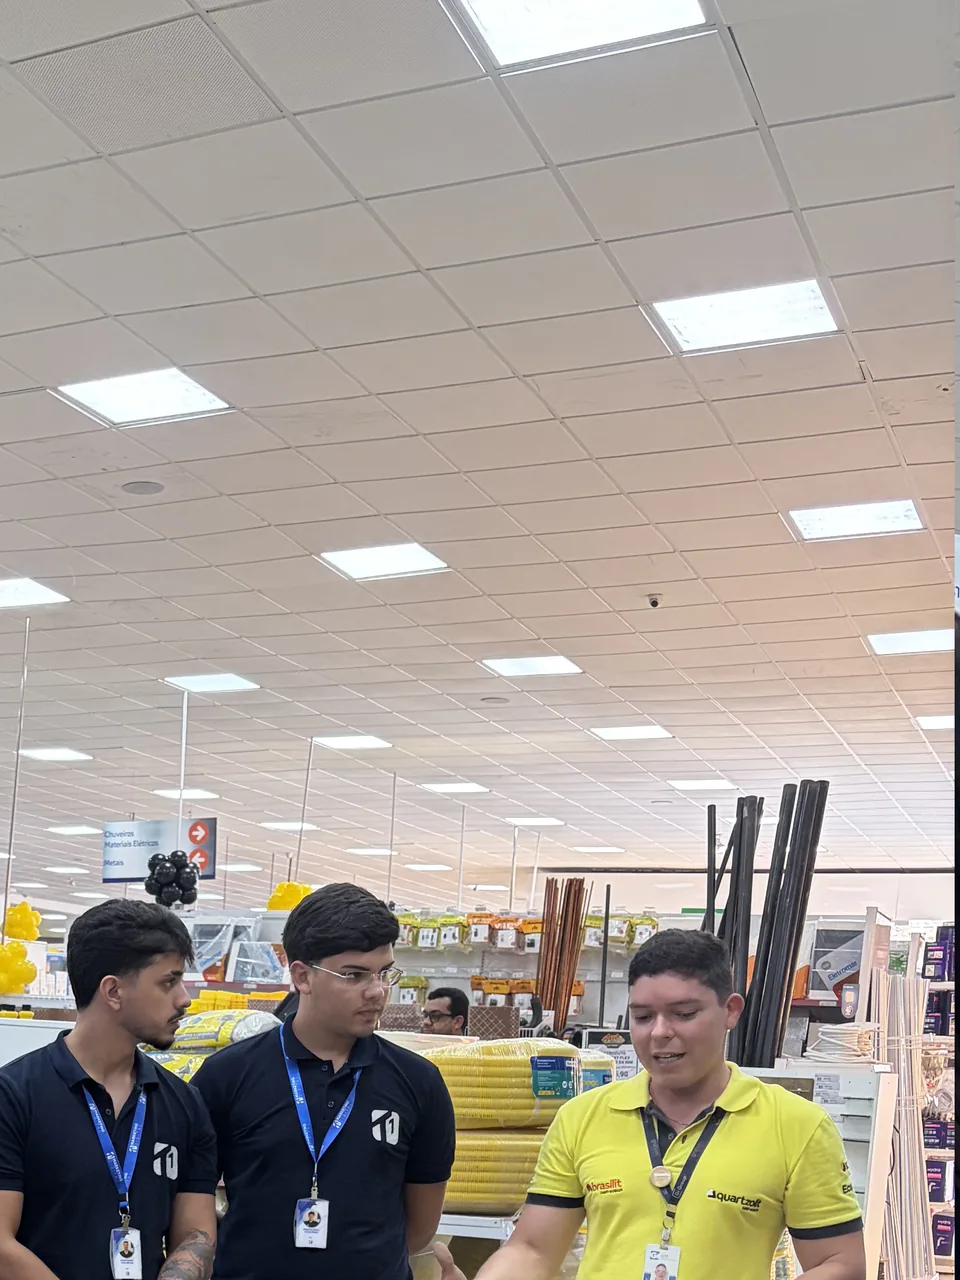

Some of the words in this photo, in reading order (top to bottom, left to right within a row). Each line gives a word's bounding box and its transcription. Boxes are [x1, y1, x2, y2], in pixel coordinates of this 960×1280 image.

[104, 830, 134, 838] Chuveiros
[104, 840, 132, 848] Materiais
[133, 839, 159, 847] Elétricos
[104, 858, 124, 866] Metais
[591, 1178, 623, 1192] brasilit
[717, 1192, 762, 1208] quartzolit
